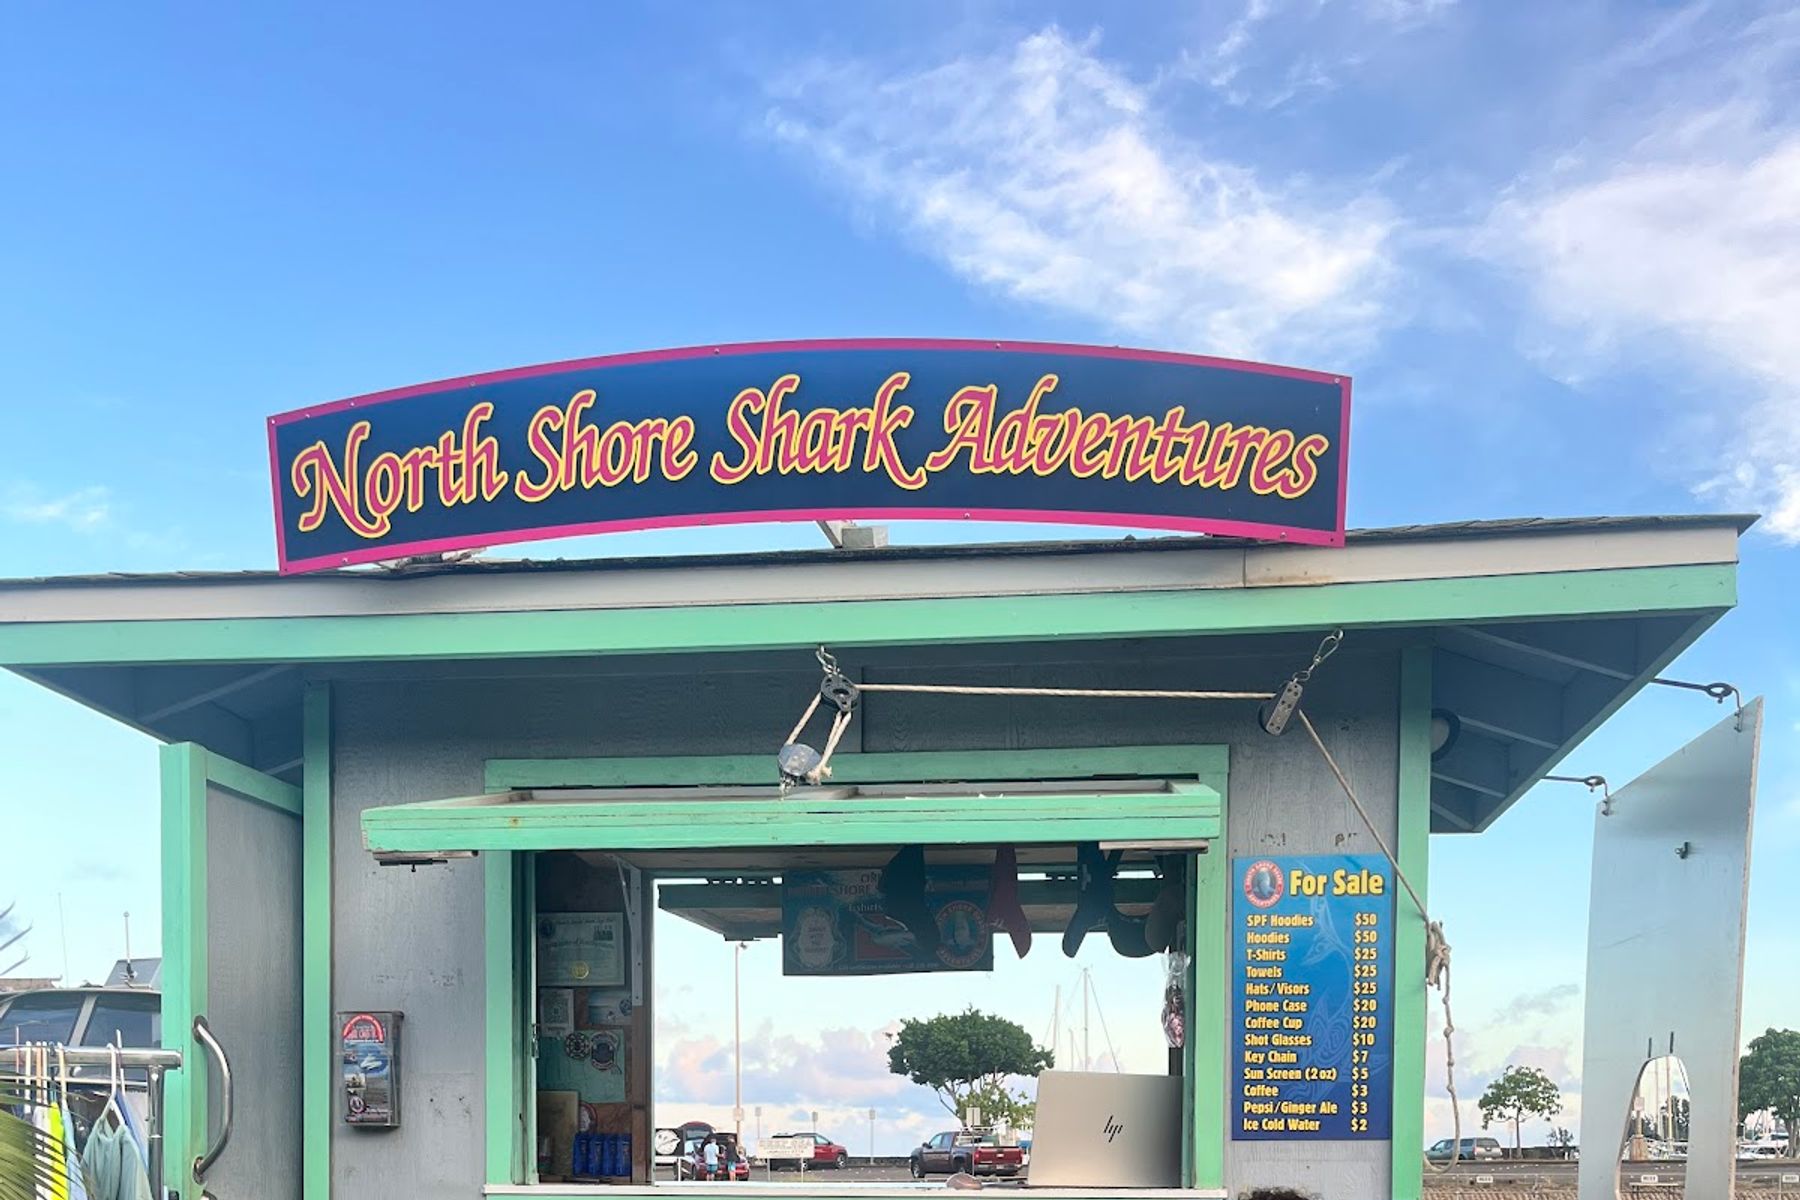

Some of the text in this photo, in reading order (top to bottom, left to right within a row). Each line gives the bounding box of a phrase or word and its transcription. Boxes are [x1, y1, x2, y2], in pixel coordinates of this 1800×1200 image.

[291, 371, 1329, 539] North Shore Shark Adventures
[1289, 869, 1327, 896] For
[1333, 868, 1385, 895] Sale
[1246, 912, 1378, 927] SPF Hoodies $50
[1246, 929, 1378, 944] Hoodies $50
[1246, 946, 1377, 961] T-Shirts $25
[1245, 963, 1377, 978] Towels $25
[1353, 981, 1377, 996] $25
[1245, 998, 1377, 1013] Phone Case $20
[1244, 1015, 1377, 1030] Coffee Cup $20
[1244, 1032, 1375, 1046] Shot Glasses $10
[1244, 1051, 1265, 1064] Key
[1267, 1050, 1298, 1063] Chain
[1243, 1067, 1264, 1080] Sun
[1266, 1067, 1302, 1080] Screen
[1243, 1084, 1279, 1097] Coffee
[1319, 1101, 1338, 1114] Ale
[1103, 1114, 1124, 1143] hp
[1243, 1118, 1259, 1131] Ice
[1261, 1118, 1285, 1131] Cold
[1287, 1118, 1321, 1131] Water
